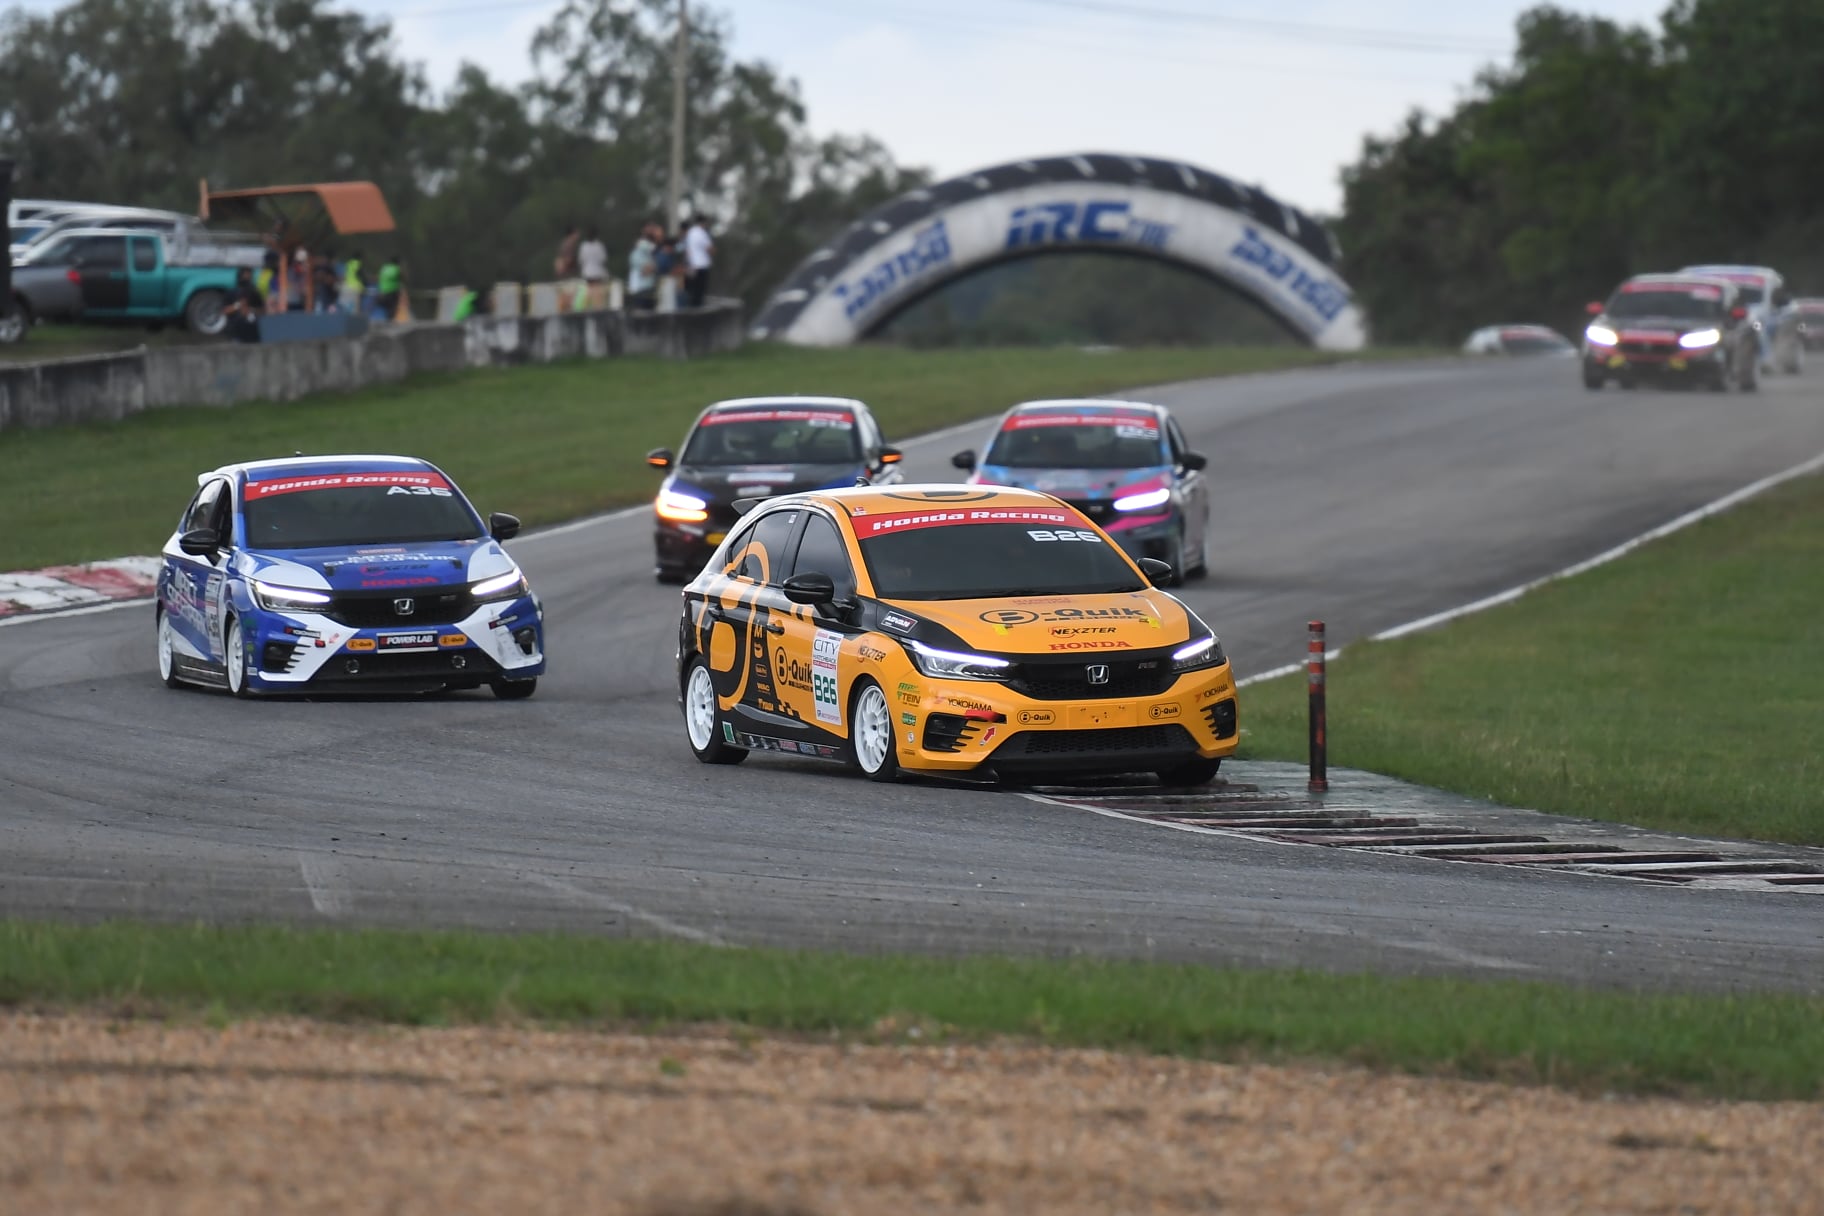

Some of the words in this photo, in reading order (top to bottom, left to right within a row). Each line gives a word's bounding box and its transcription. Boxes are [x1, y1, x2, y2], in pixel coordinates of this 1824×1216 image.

[260, 478, 342, 493] Honda
[346, 476, 431, 484] Racing
[387, 486, 453, 497] A36
[873, 513, 965, 530] Honda
[971, 511, 1065, 522] Racing
[1027, 530, 1102, 543] B26
[979, 608, 1146, 625] B-Quik
[1051, 627, 1117, 637] NEXZTER
[386, 635, 416, 645] POWER
[416, 635, 433, 643] LAB
[1050, 641, 1132, 650] HONDA
[814, 639, 839, 655] CITY
[774, 646, 813, 685] B-Quik
[814, 673, 838, 705] B26
[902, 692, 921, 704] TEIN
[948, 698, 993, 712] YOKOHAMA
[1151, 704, 1179, 717] B-Quik
[1020, 711, 1051, 723] B-Quik
